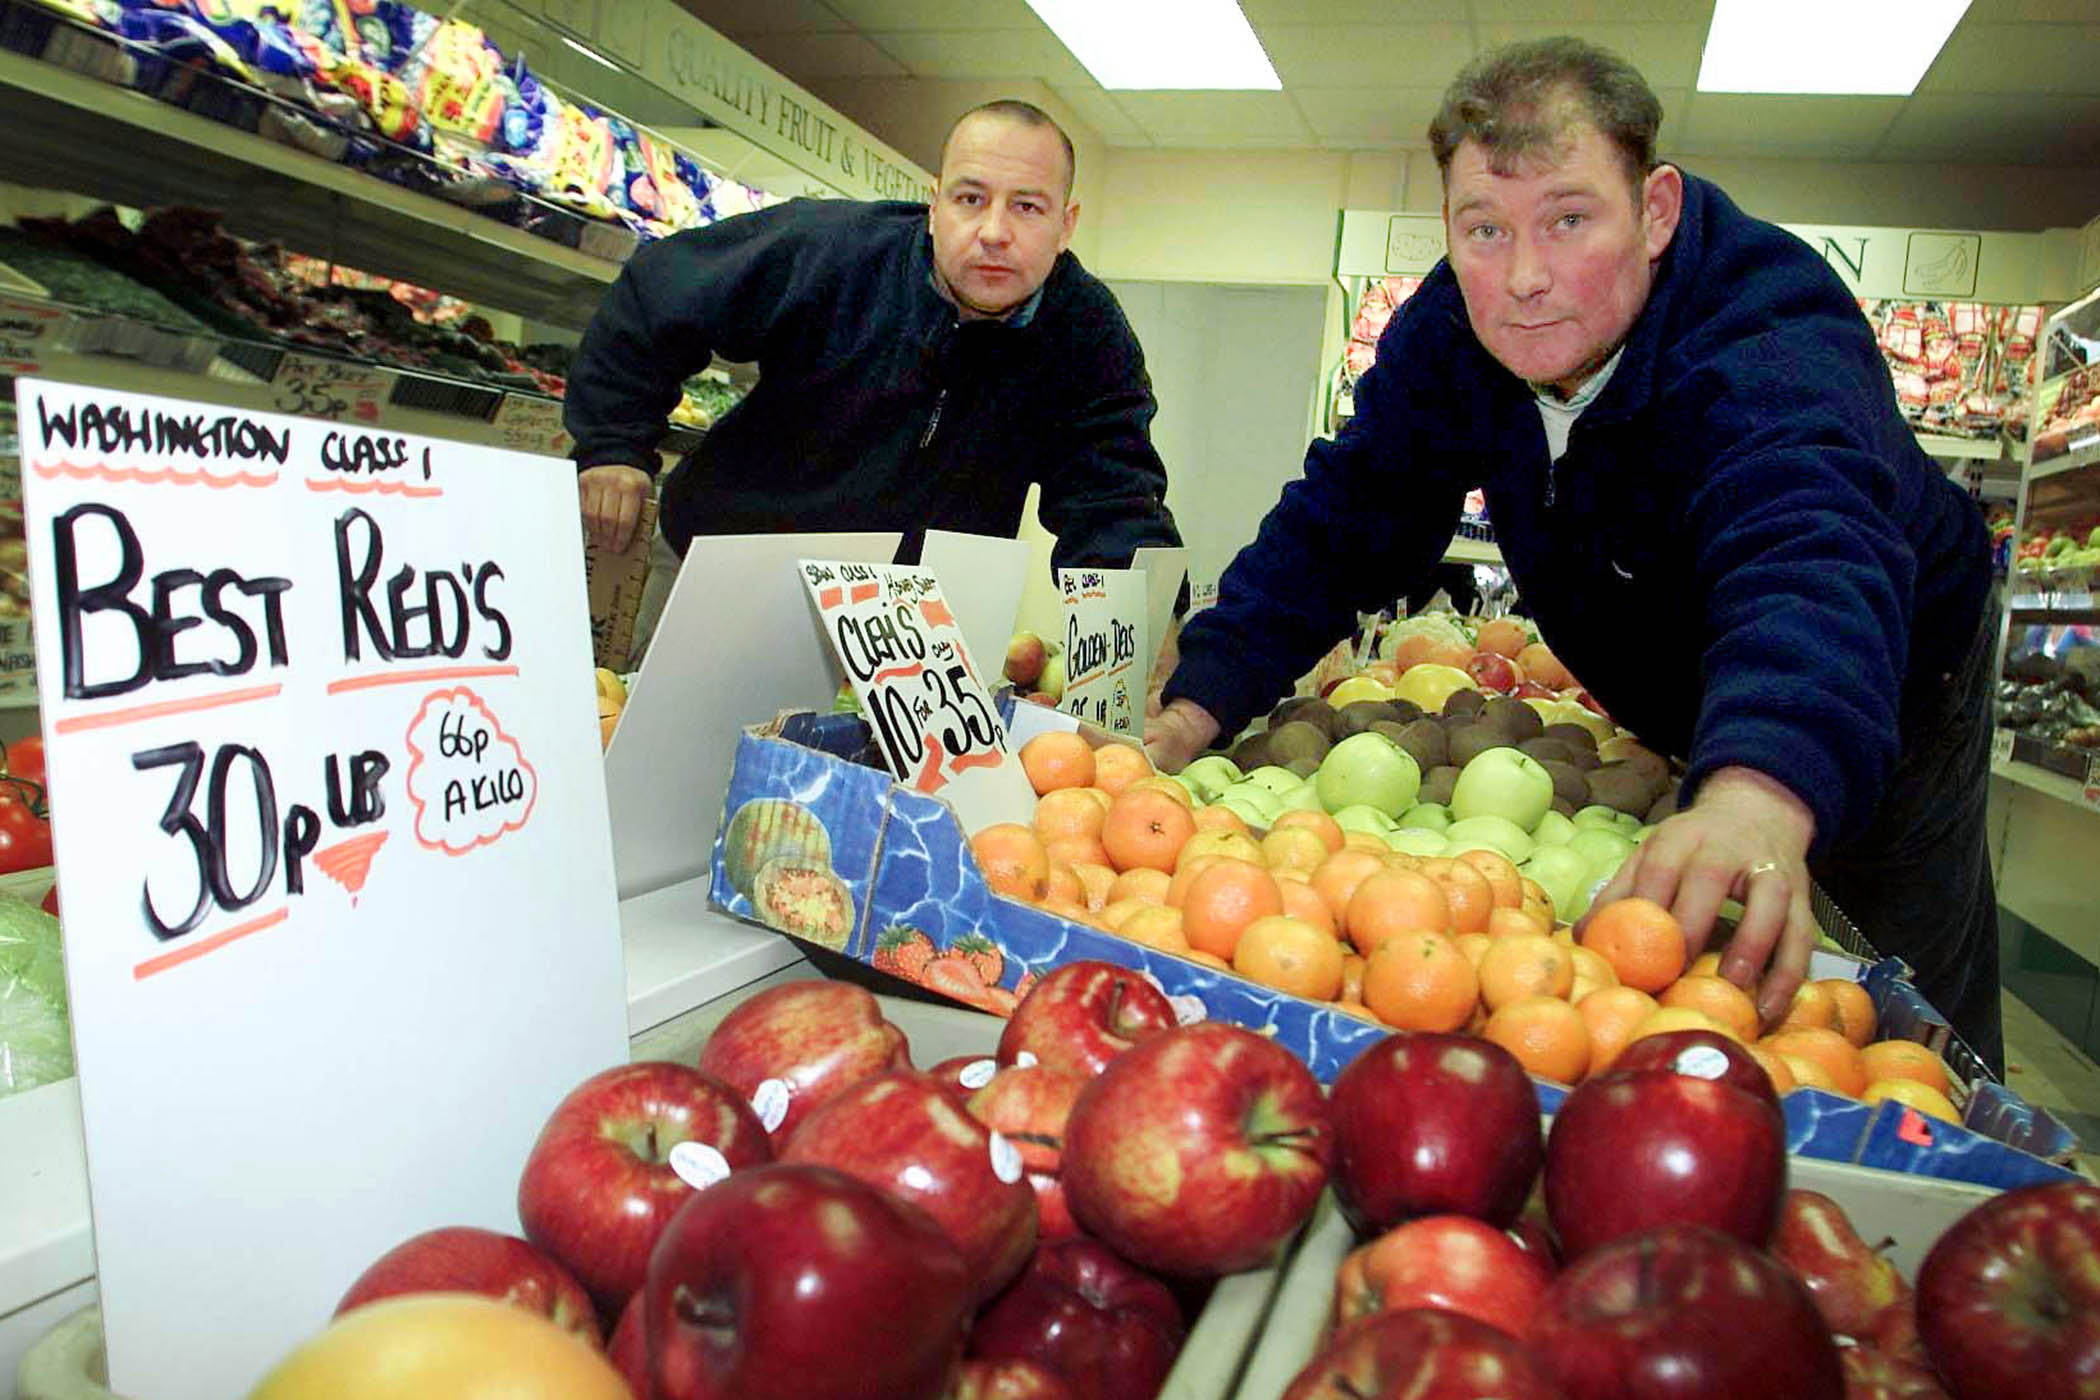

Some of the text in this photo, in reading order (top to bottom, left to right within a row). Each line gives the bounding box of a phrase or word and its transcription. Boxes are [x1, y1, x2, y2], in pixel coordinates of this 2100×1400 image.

[667, 29, 769, 126] QUALITY
[777, 95, 838, 163] FRUIT
[840, 137, 856, 178] &
[37, 394, 432, 482] WASHINGTON CLASS 1
[52, 501, 293, 701] BEST
[333, 507, 514, 663] RED'S
[439, 711, 490, 763] 66p
[867, 685, 923, 783] 10
[324, 750, 391, 828] LB
[444, 768, 524, 821] A KILO
